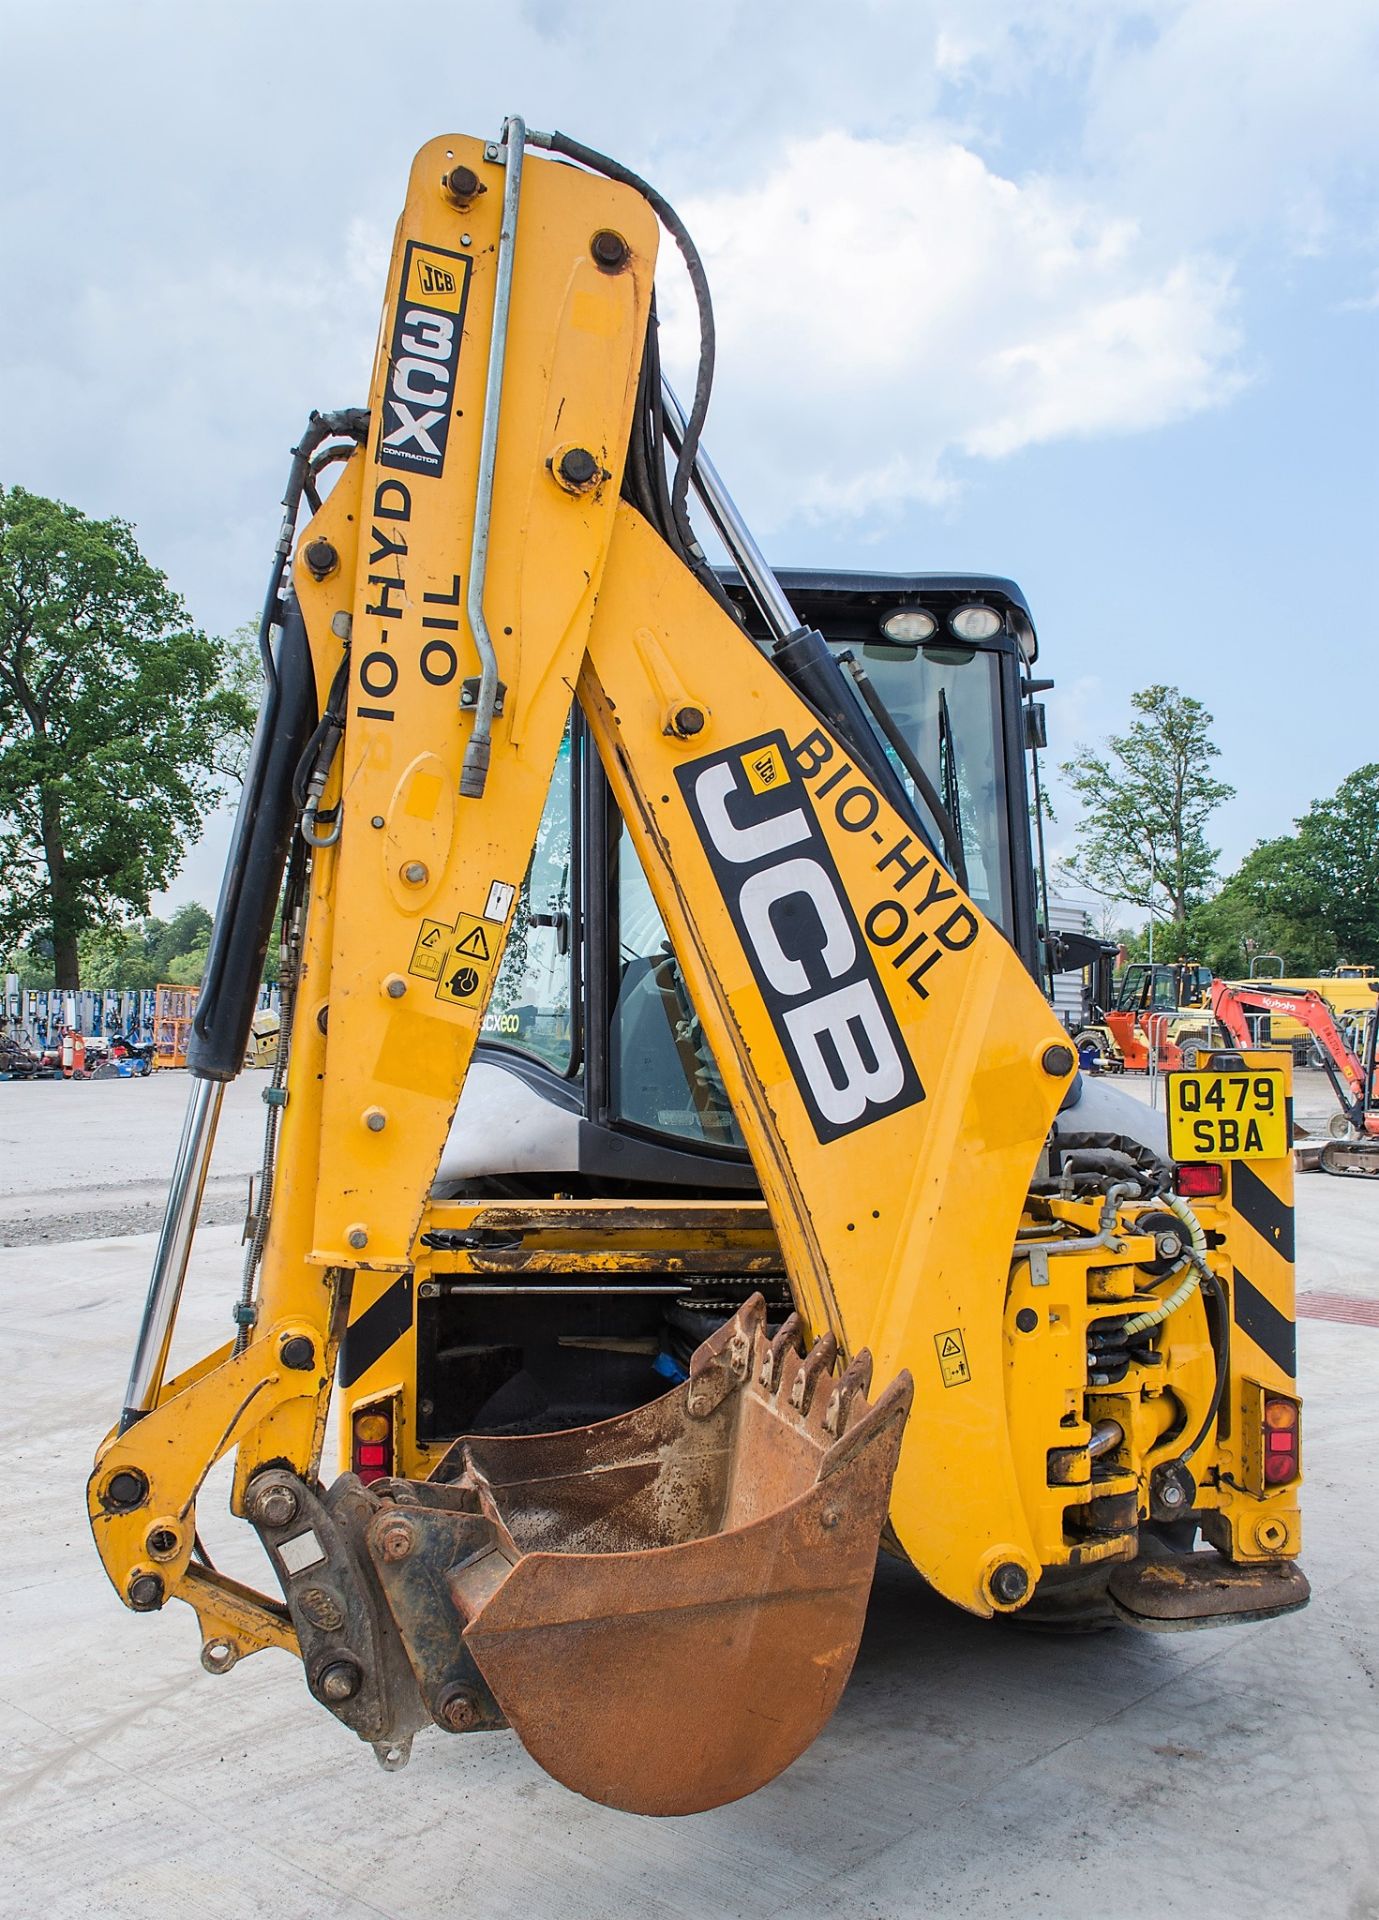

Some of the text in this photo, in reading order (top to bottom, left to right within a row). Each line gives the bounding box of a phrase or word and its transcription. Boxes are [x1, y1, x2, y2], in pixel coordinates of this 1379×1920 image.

[422, 264, 454, 293] JCB
[382, 310, 454, 457] 3CX
[383, 447, 439, 465] CONTRACTOR
[420, 574, 461, 686] OIL
[754, 757, 775, 784] JCB
[795, 728, 979, 951] BIO-HYD
[695, 762, 905, 1125] JCB
[864, 899, 943, 1000] OIL
[1262, 996, 1297, 1012] Kubota
[1179, 1077, 1274, 1112] Q479
[1193, 1118, 1264, 1153] SBA
